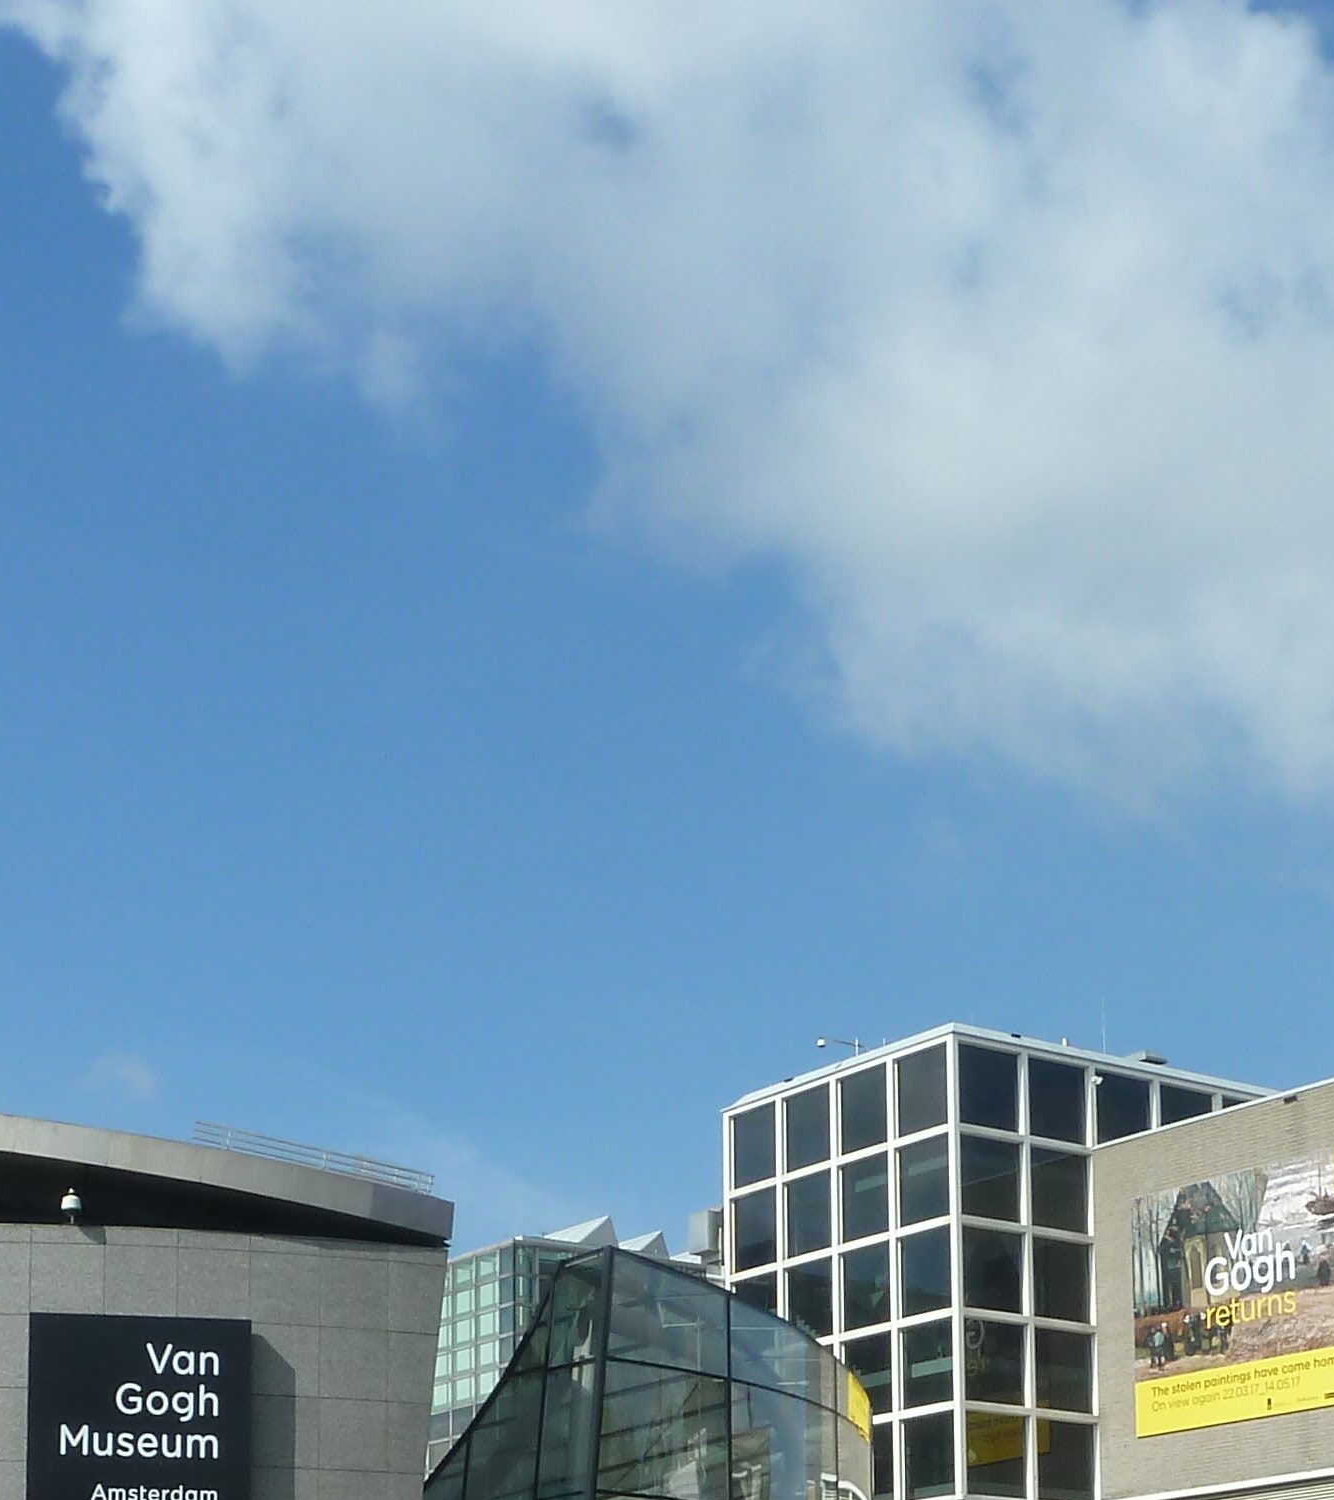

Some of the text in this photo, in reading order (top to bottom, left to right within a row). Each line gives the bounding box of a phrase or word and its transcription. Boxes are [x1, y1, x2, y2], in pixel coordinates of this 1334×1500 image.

[1223, 1228, 1273, 1260] Van
[1205, 1242, 1296, 1296] Gogh
[1206, 1291, 1296, 1329] returns
[146, 1342, 220, 1376] Van
[1151, 1386, 1169, 1397] The
[1172, 1381, 1202, 1394] stolen
[1204, 1372, 1251, 1390] paintings
[1254, 1366, 1279, 1379] have
[1281, 1361, 1311, 1374] come
[115, 1382, 219, 1422] Gogh
[1151, 1400, 1167, 1412] On
[59, 1424, 219, 1459] Museum
